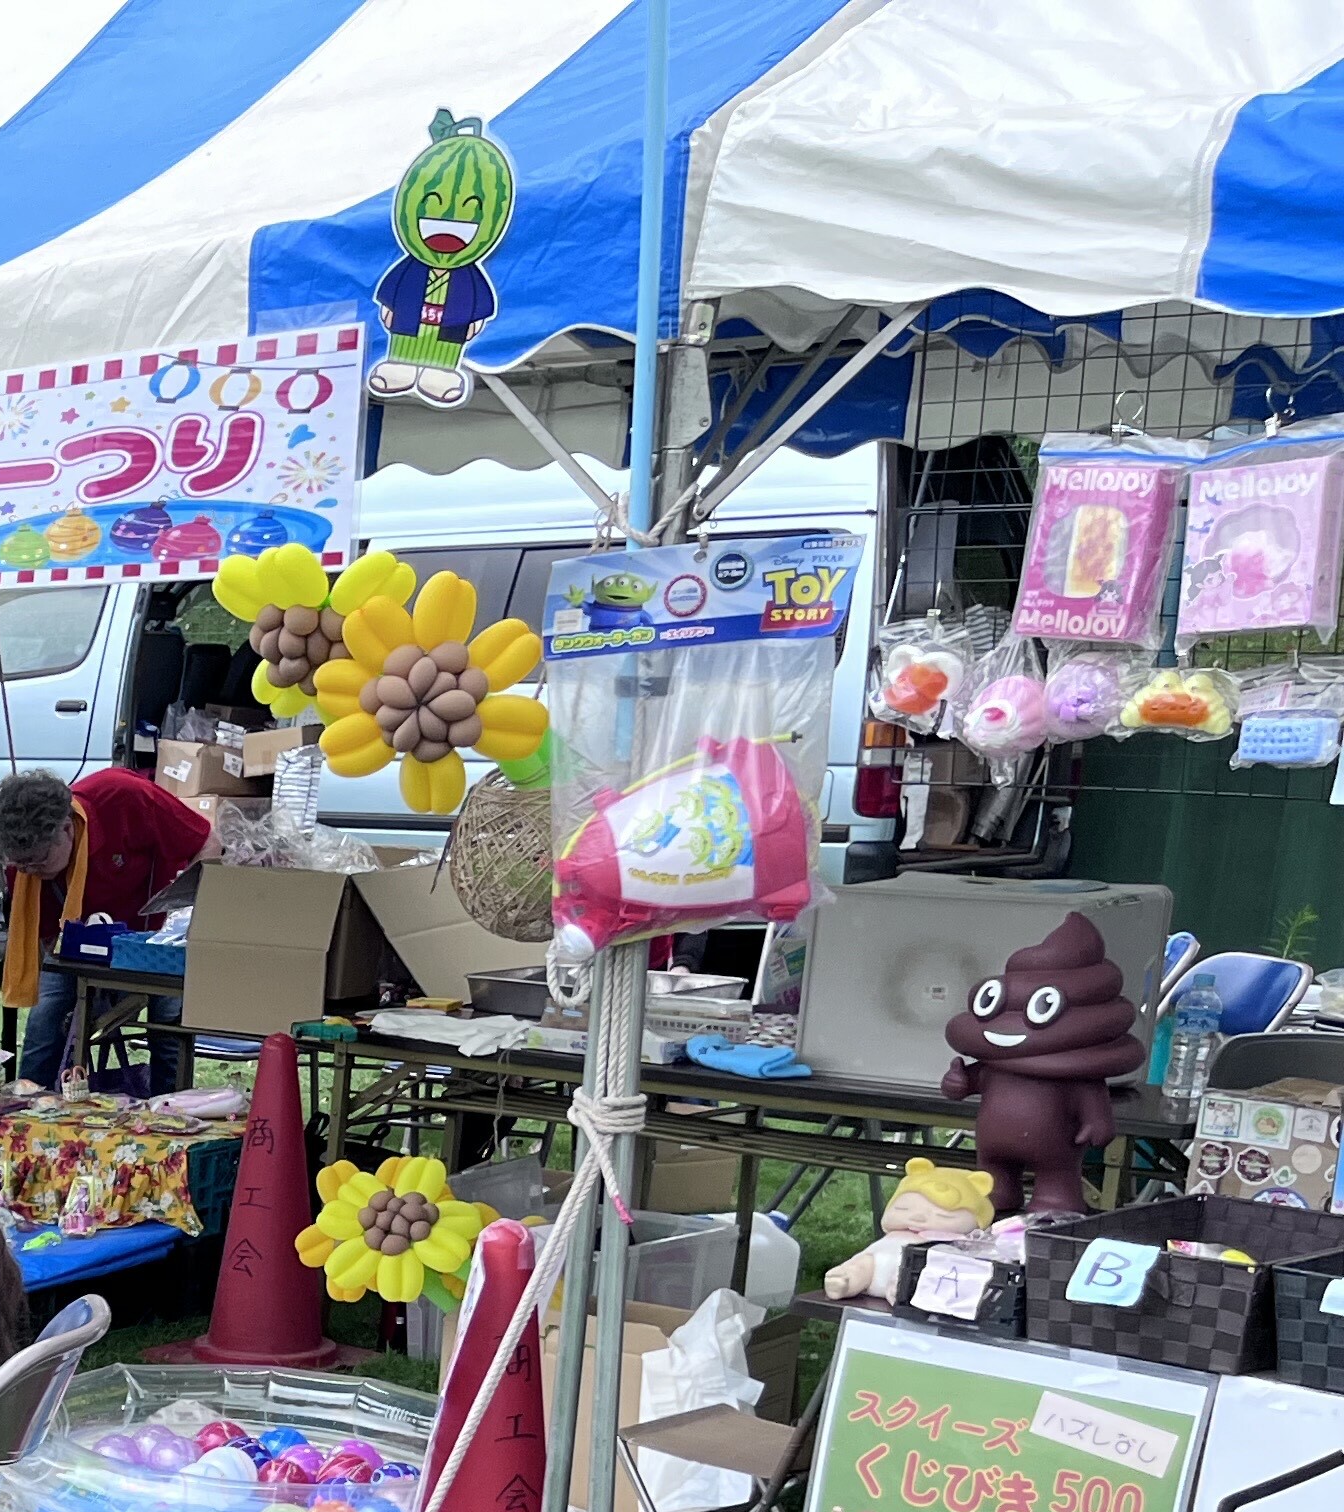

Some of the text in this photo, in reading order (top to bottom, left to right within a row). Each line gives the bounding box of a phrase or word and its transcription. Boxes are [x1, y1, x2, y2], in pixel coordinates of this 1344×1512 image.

[812, 554, 844, 563] PIXAR
[762, 565, 850, 608] TOY
[769, 606, 830, 623] STORY
[229, 1115, 275, 1279] 商工会
[934, 1265, 959, 1298] A
[1083, 1251, 1132, 1287] B
[847, 1389, 1030, 1456] スクイーズ
